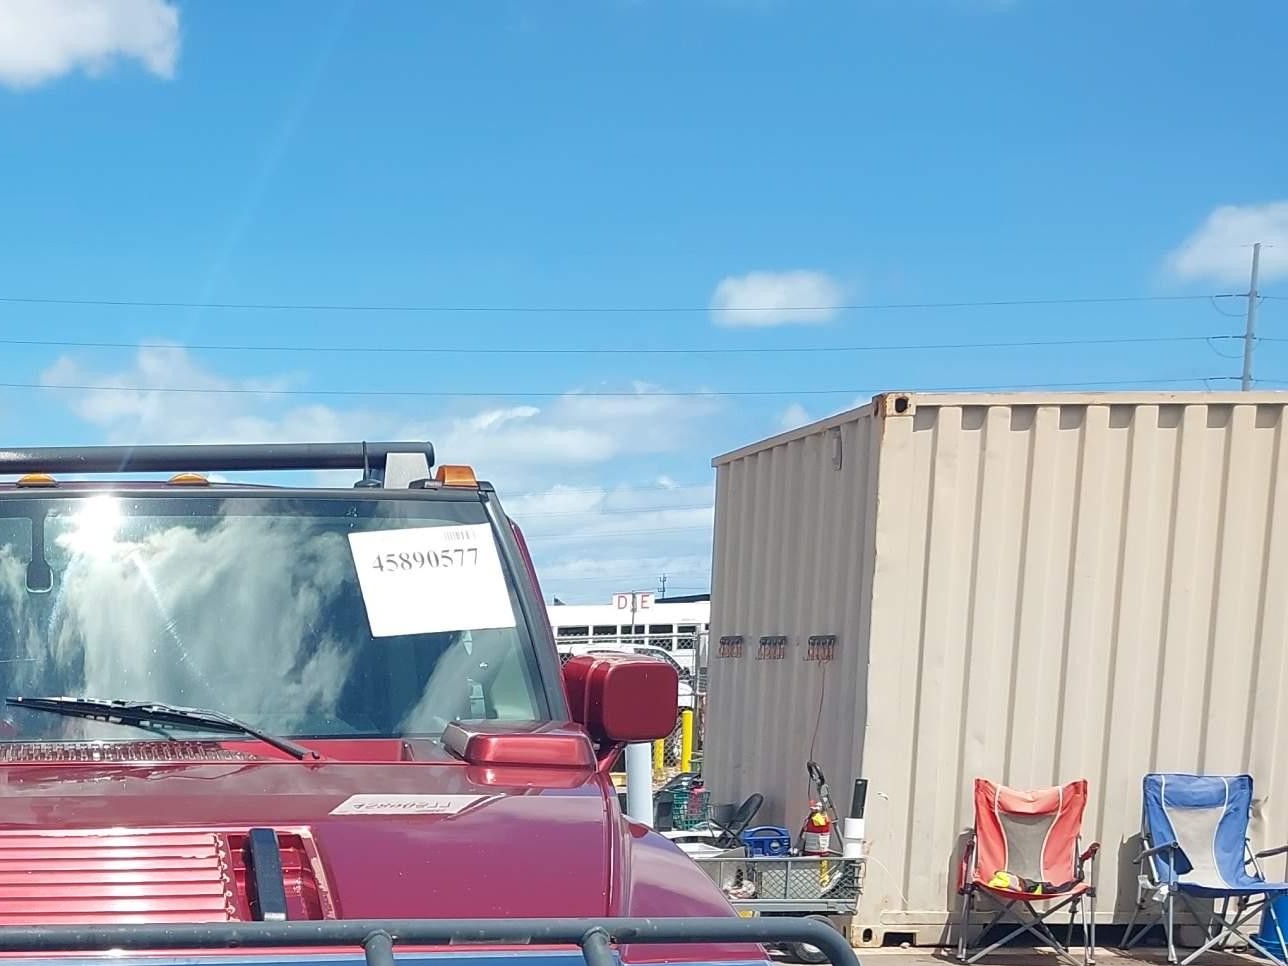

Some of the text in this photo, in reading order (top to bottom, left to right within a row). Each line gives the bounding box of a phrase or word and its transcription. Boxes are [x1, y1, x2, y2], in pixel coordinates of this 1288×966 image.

[372, 547, 478, 572] 45890577
[617, 594, 650, 609] D E
